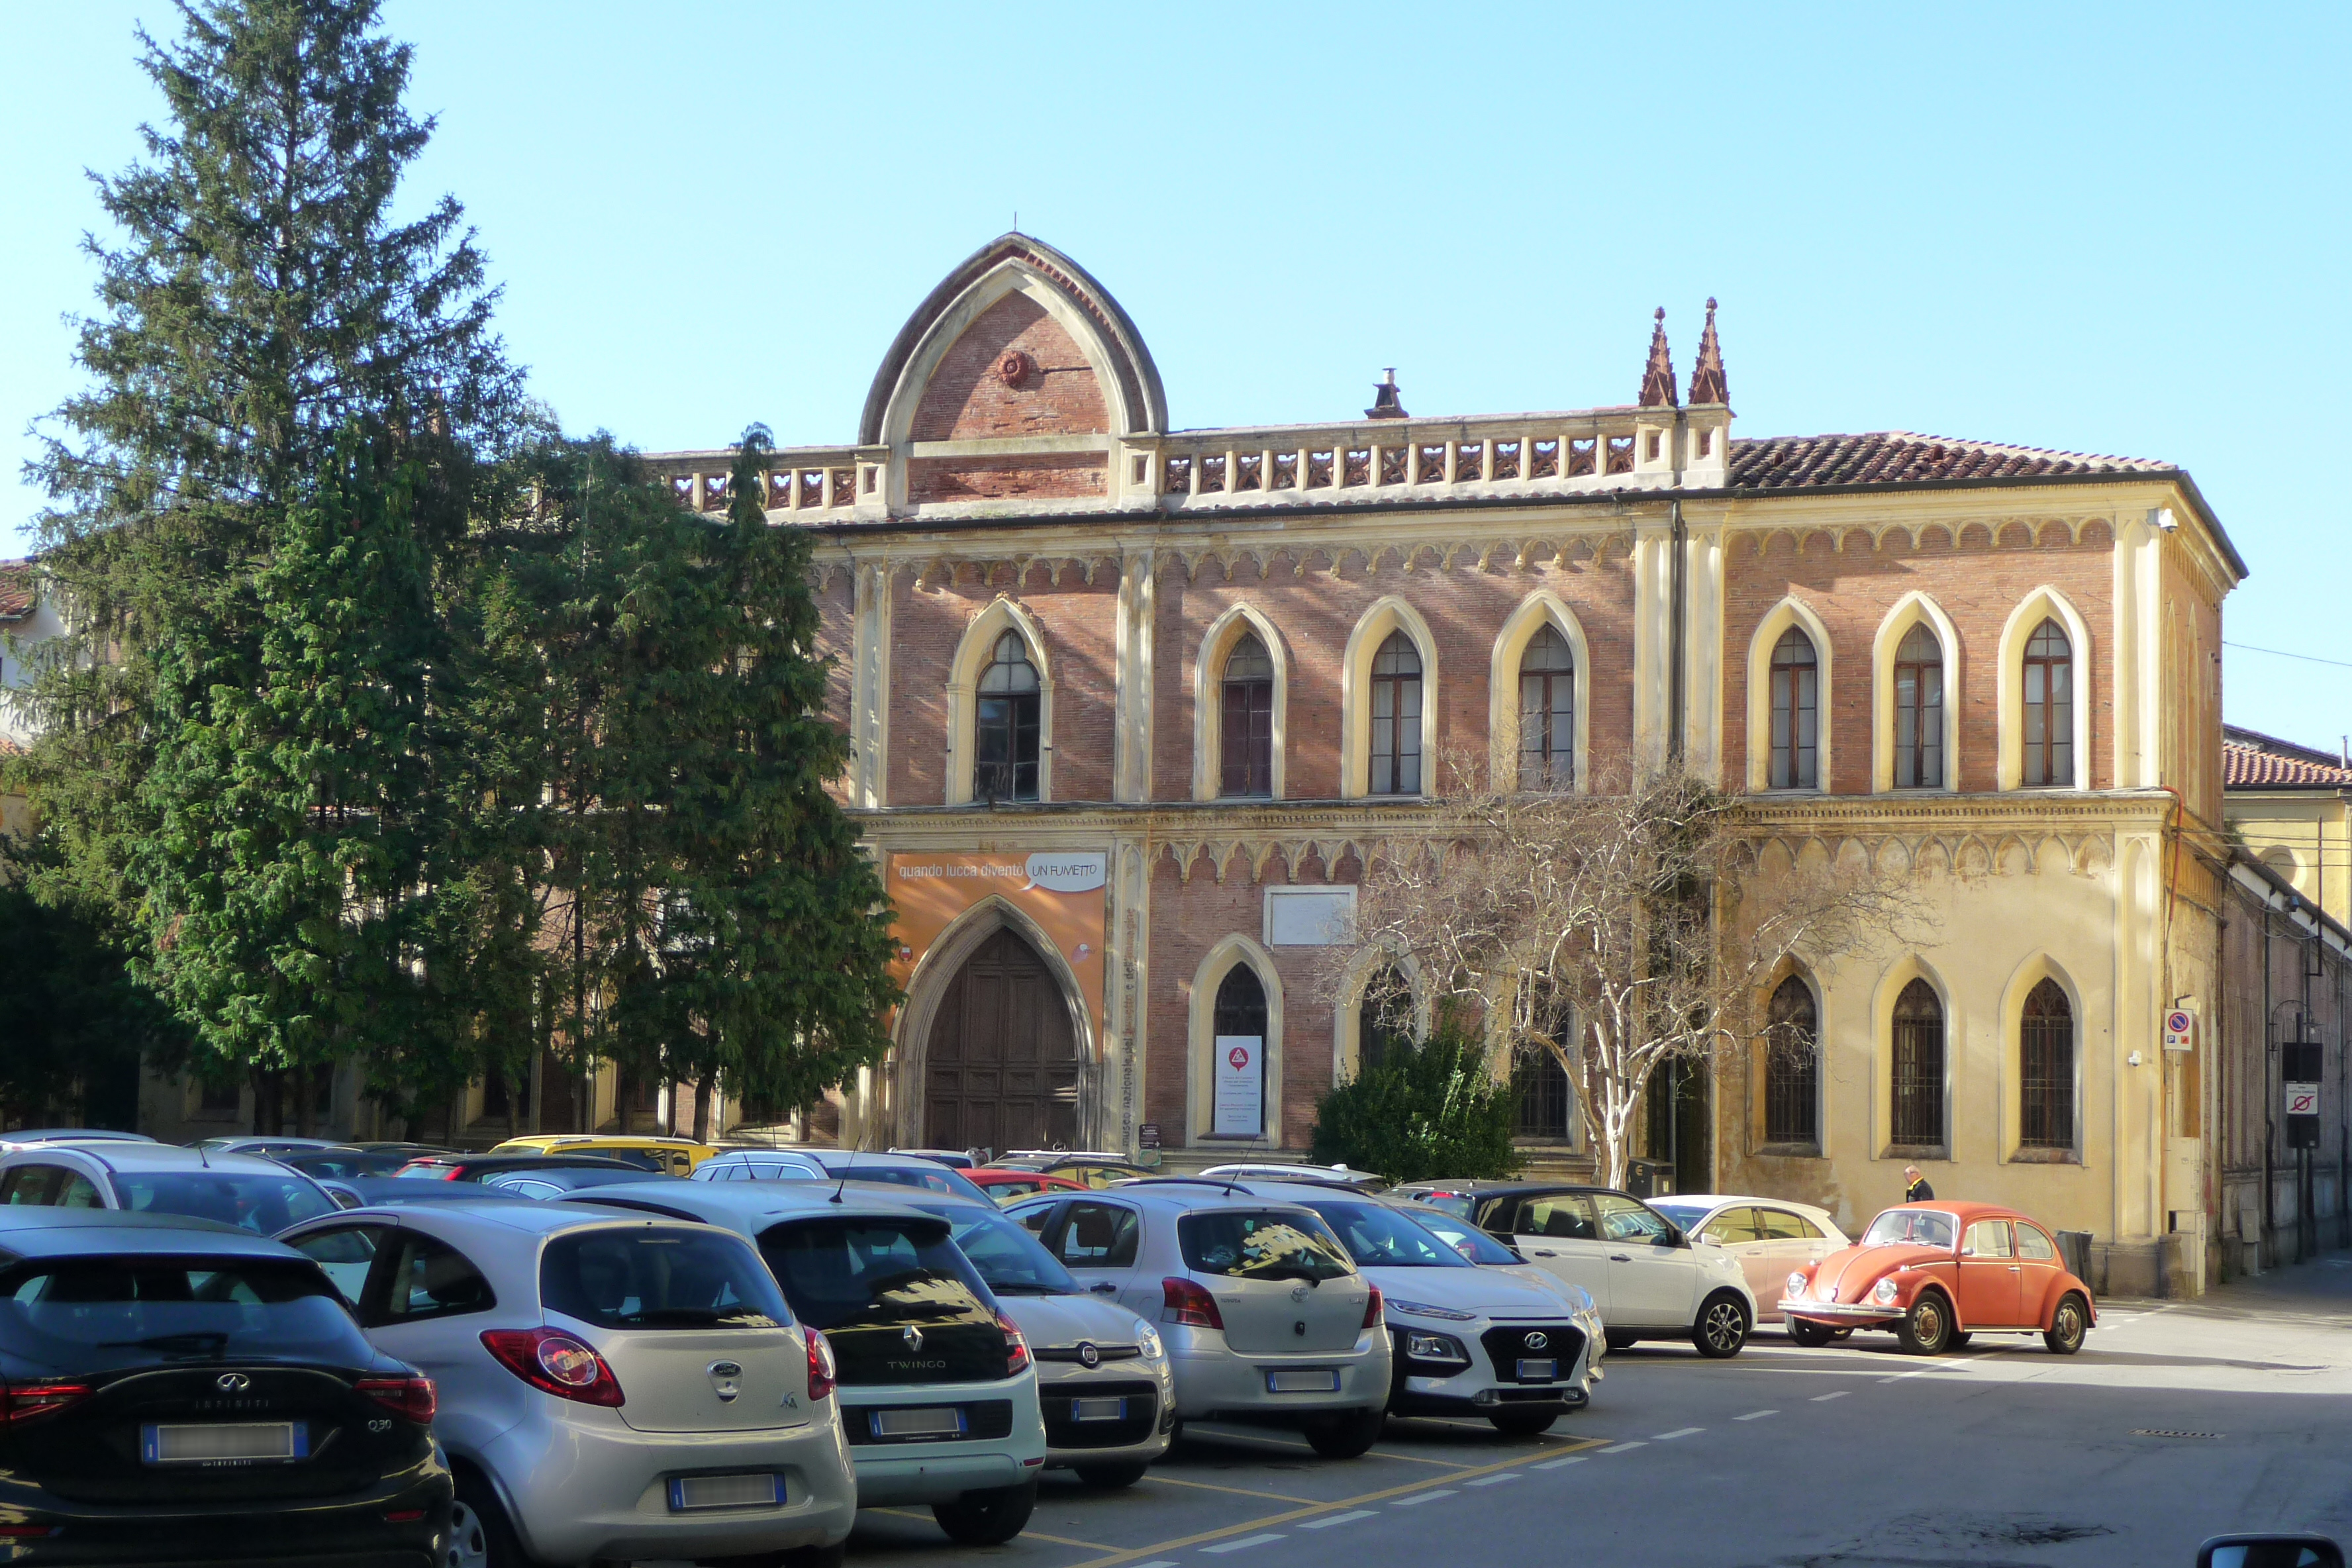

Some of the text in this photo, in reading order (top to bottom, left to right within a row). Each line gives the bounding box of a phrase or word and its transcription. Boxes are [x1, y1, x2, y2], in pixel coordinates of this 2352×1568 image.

[899, 862, 1097, 880] quando lucca diventò UN FUMETTO
[1120, 1057, 1132, 1108] nazionale
[887, 1360, 946, 1369] TWINGO
[195, 1399, 269, 1409] INFINITI
[368, 1419, 392, 1432] Q30
